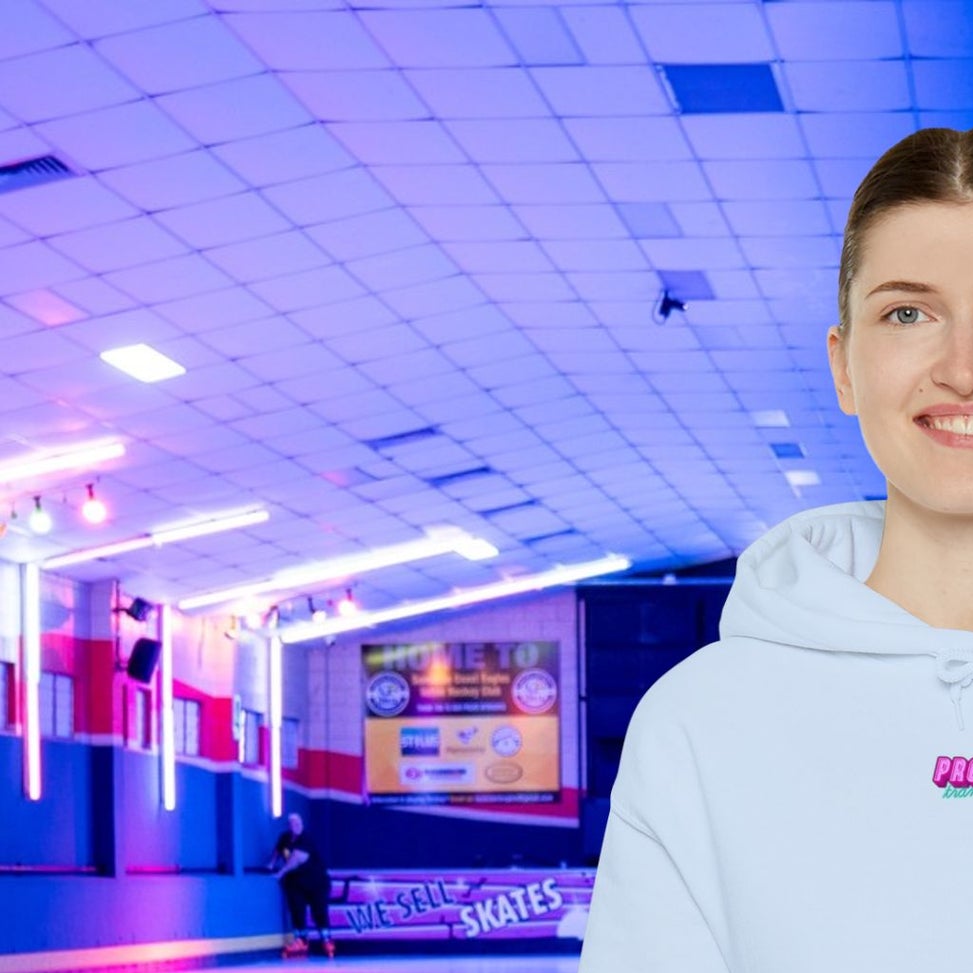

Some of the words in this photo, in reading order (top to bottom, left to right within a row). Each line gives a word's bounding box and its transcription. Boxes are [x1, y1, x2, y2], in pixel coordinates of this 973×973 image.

[497, 643, 539, 669] TO
[346, 898, 392, 934] WE
[396, 878, 455, 920] SELL
[459, 877, 564, 938] SKATES
